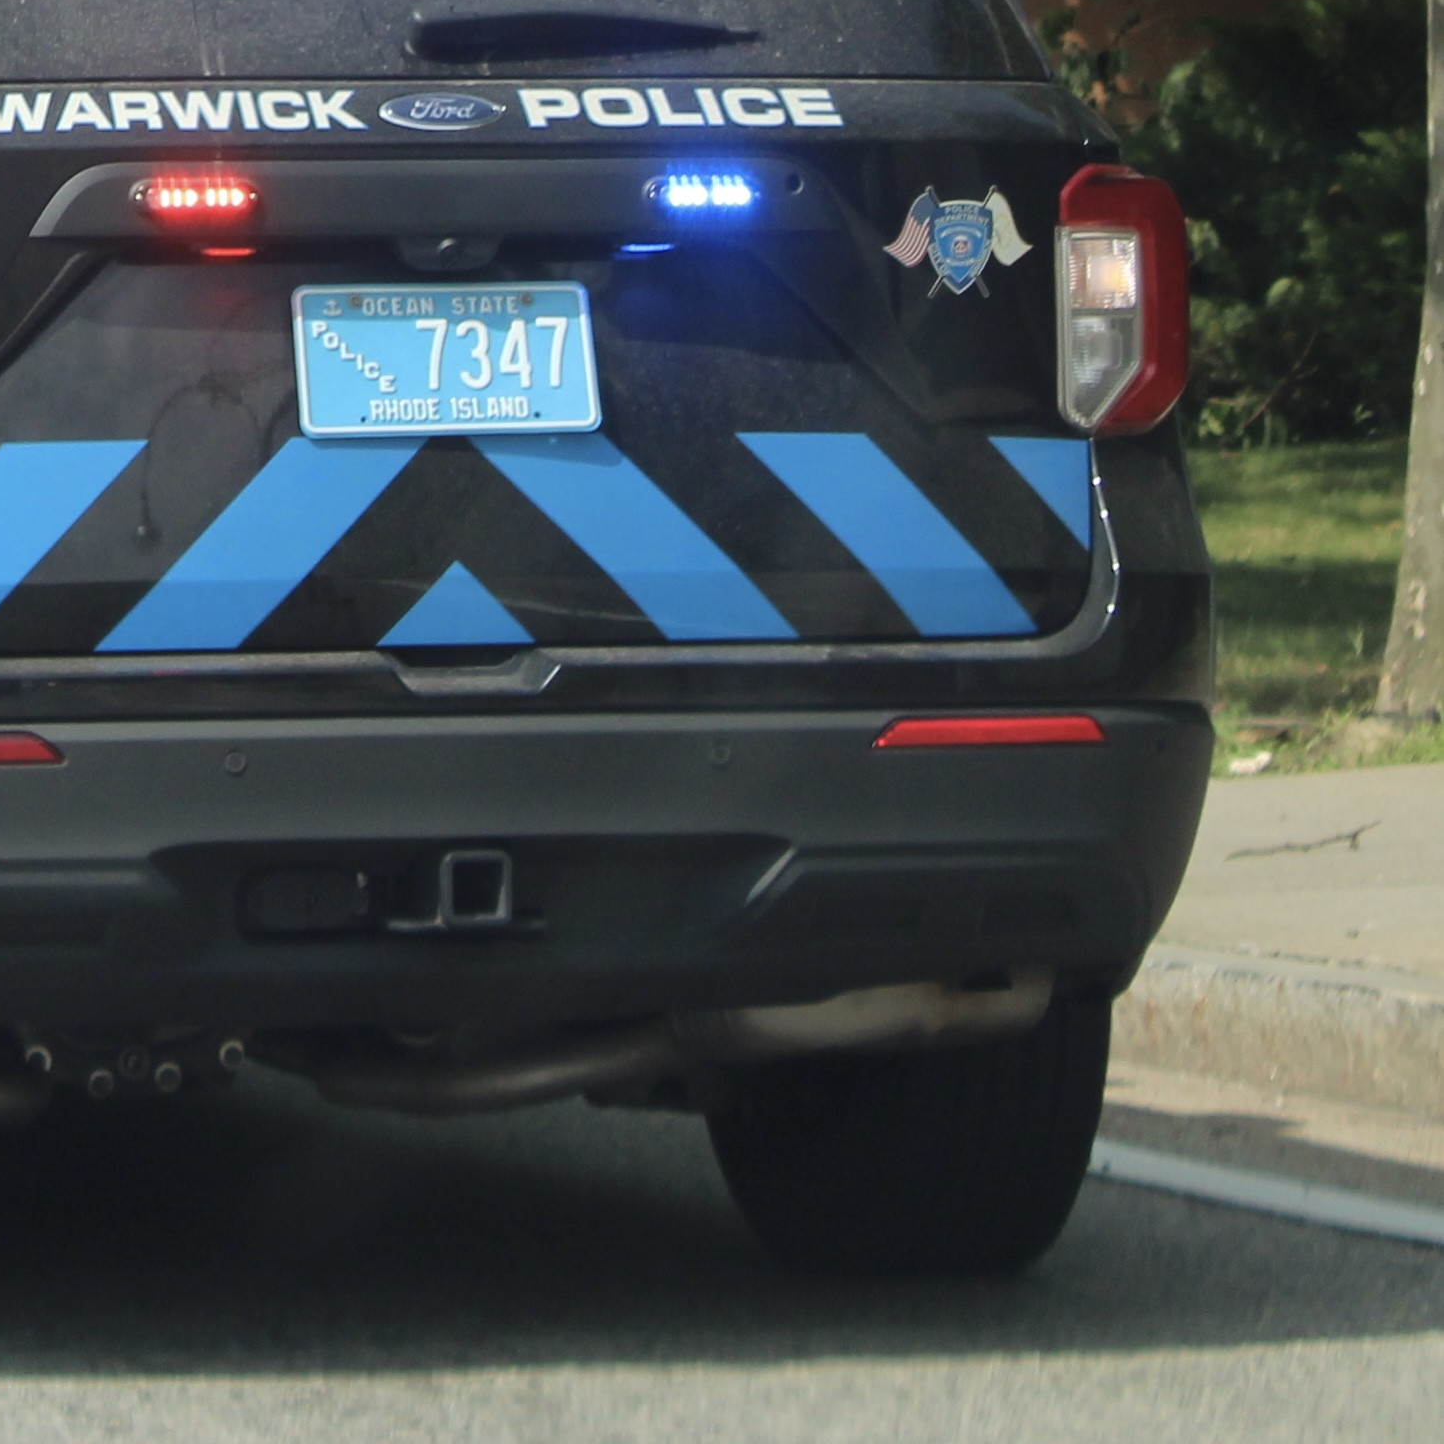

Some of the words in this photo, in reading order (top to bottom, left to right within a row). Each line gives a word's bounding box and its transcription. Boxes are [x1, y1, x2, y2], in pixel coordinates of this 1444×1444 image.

[410, 97, 477, 120] Ford
[516, 88, 844, 129] POLICE
[362, 296, 434, 317] OCEAN
[451, 296, 520, 316] STATE
[311, 320, 397, 393] POLICE
[415, 316, 569, 391] 7347
[369, 397, 441, 422] RHODE
[451, 396, 530, 420] ISLAND
